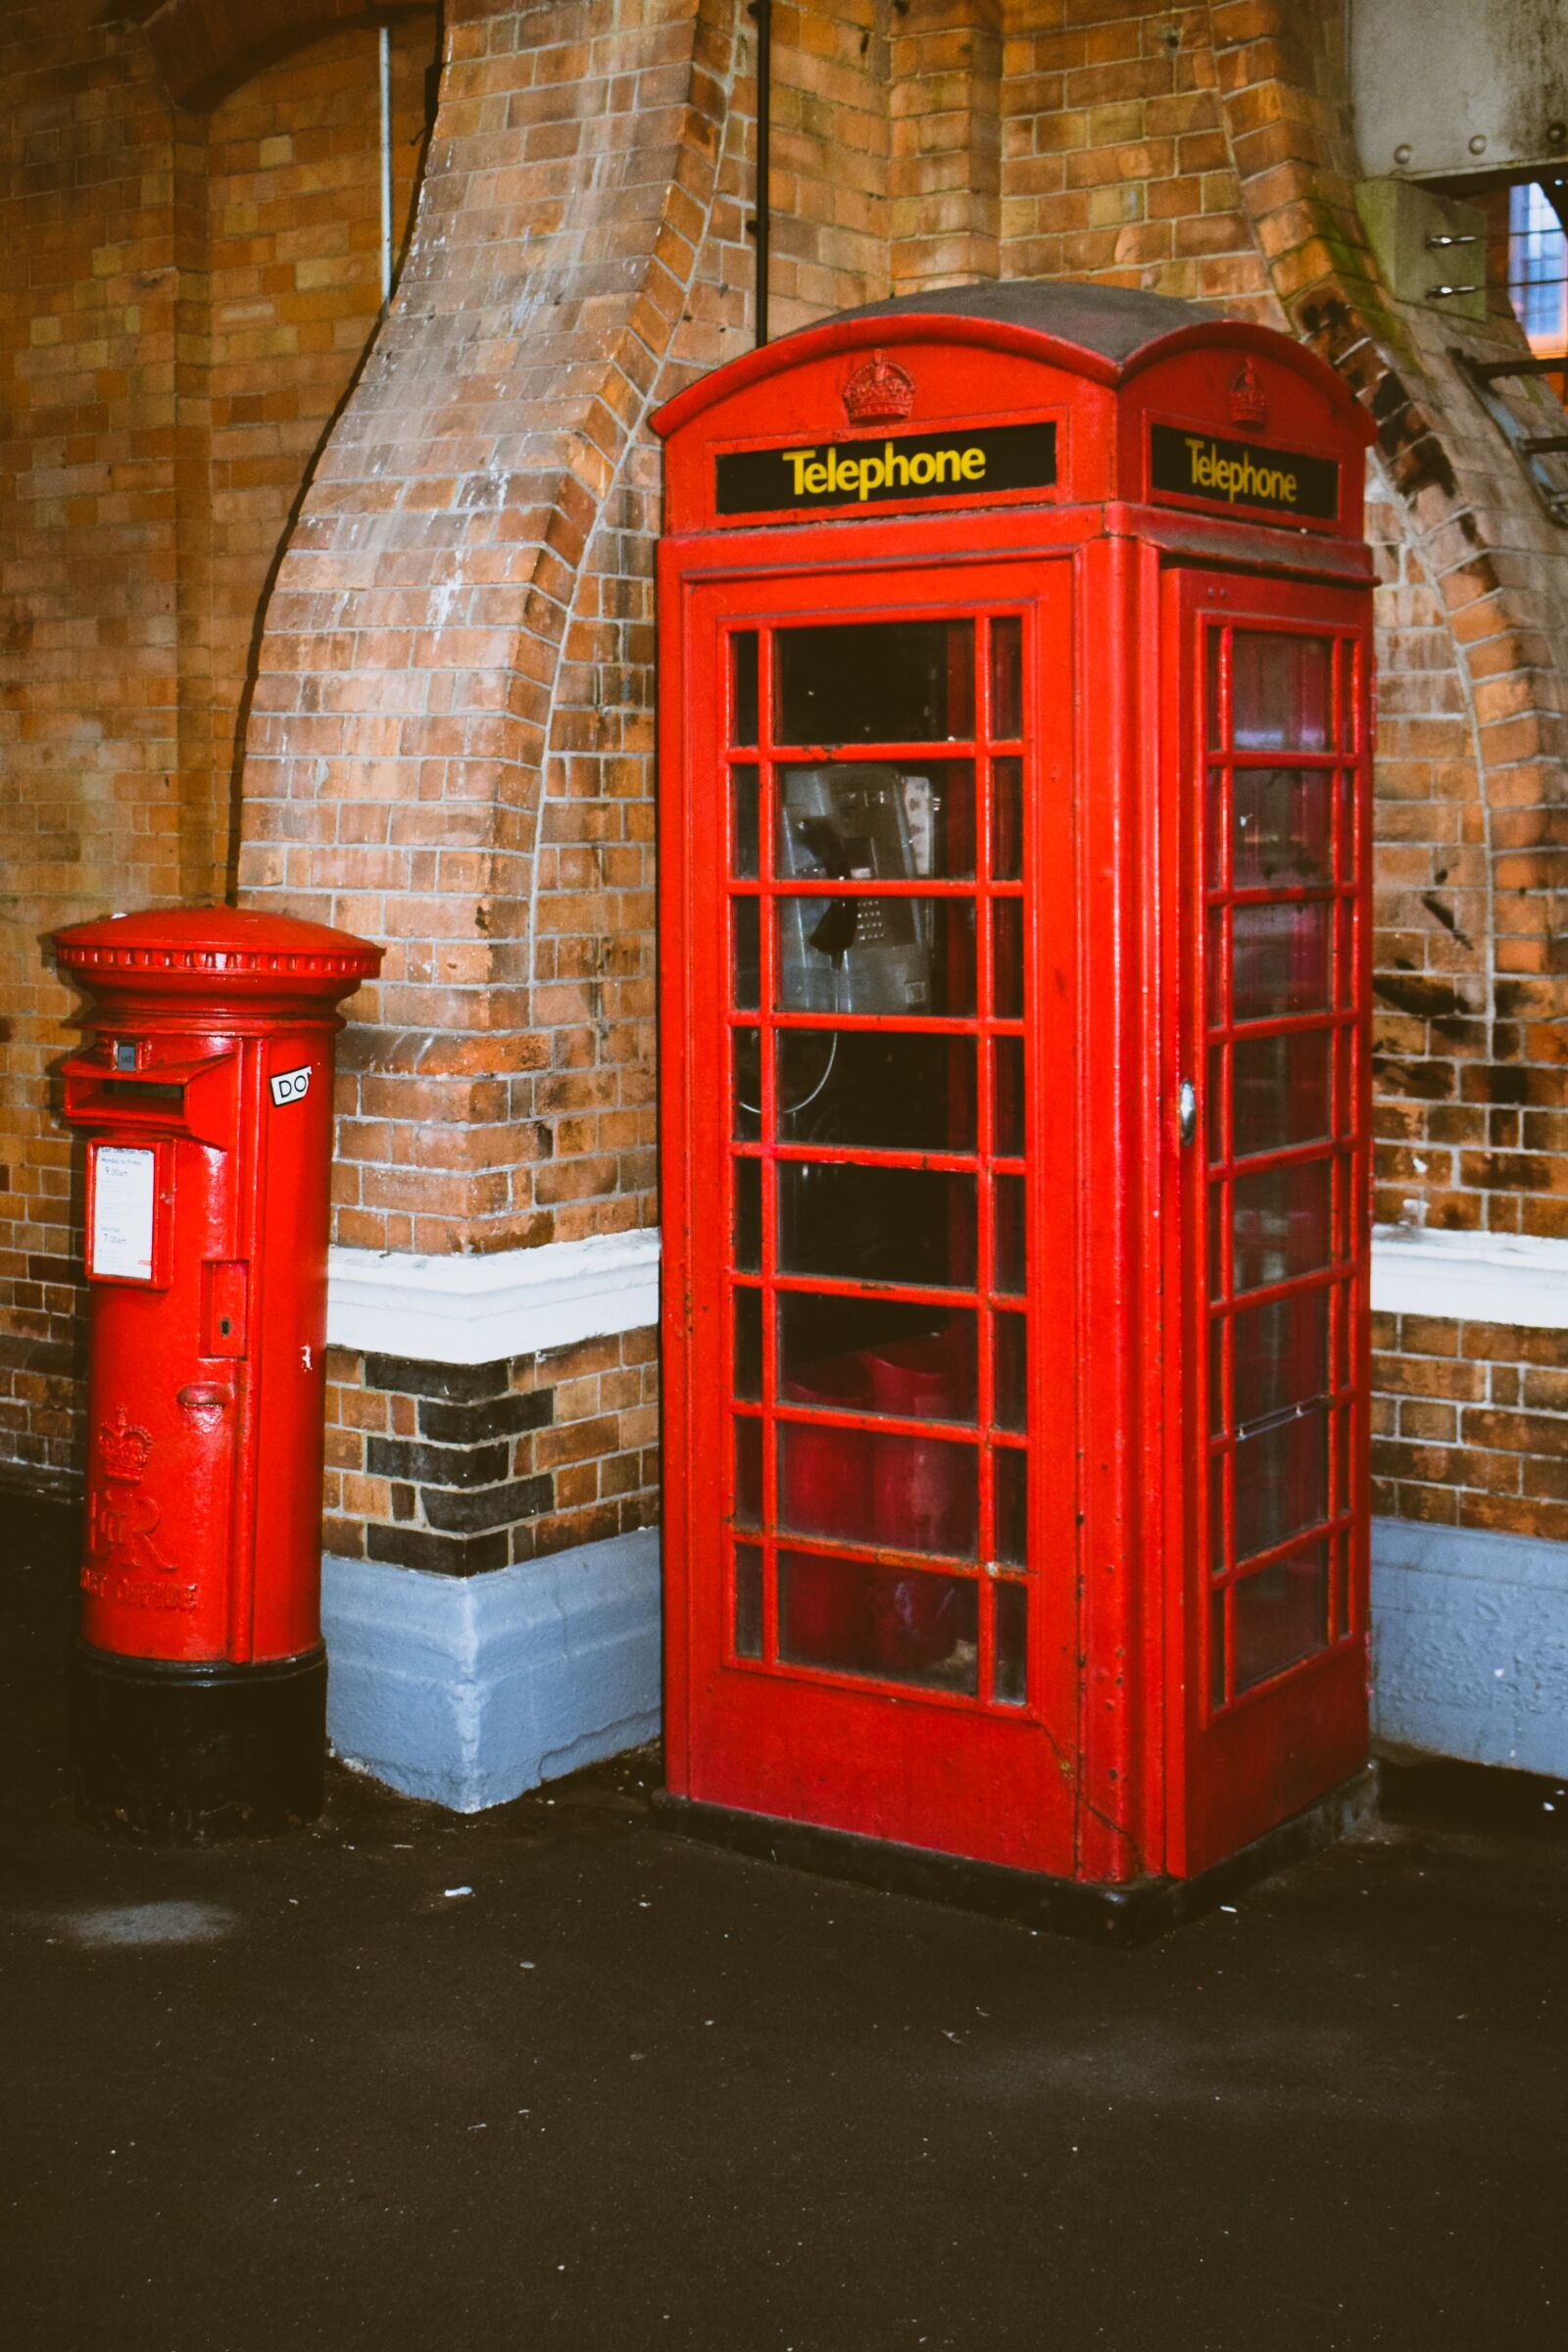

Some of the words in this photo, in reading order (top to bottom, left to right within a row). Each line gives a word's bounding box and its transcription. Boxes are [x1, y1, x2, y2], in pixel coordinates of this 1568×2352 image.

[782, 441, 987, 501] Telephone
[1184, 437, 1298, 503] Telephone
[278, 1071, 310, 1099] DO
